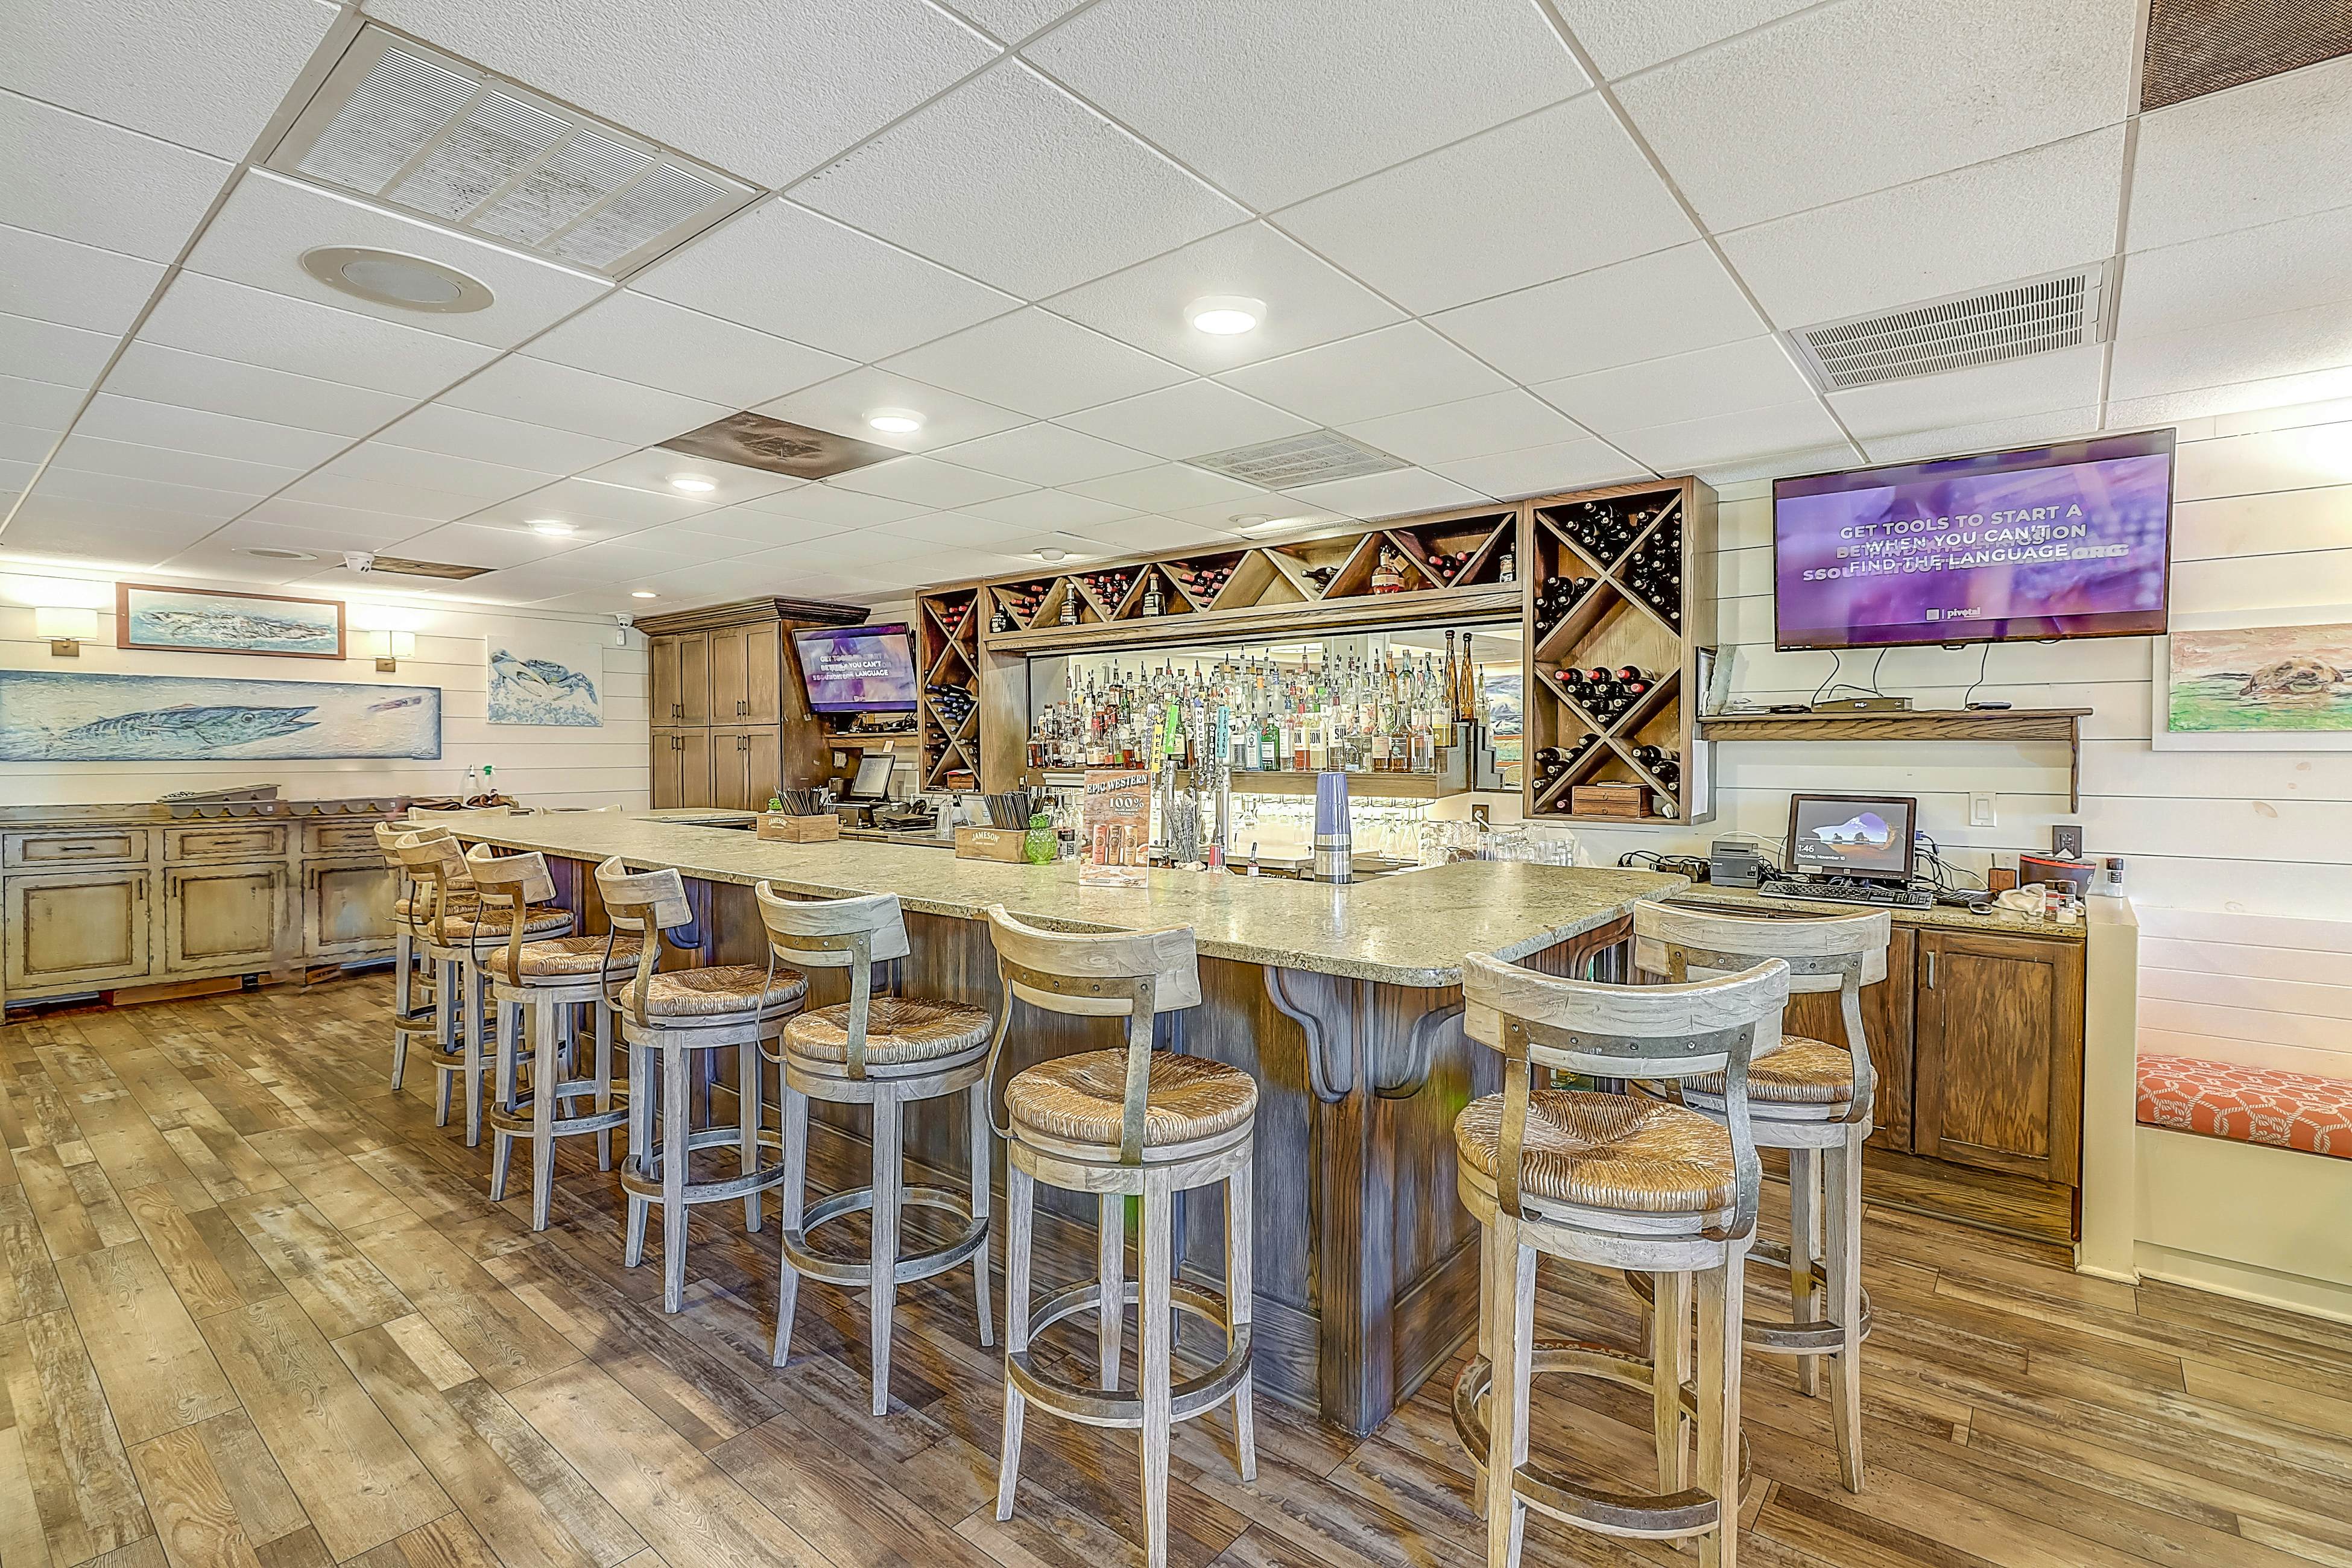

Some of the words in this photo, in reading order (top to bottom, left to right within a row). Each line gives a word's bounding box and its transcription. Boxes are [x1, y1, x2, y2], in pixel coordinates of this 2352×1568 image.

[1840, 524, 1877, 539] GET
[1882, 516, 1950, 536] TOOLS
[1955, 513, 1984, 529] TO
[1991, 505, 2060, 525] START
[2066, 504, 2083, 518] A
[1865, 536, 1927, 554] WHEN
[1933, 531, 1977, 547] YOU
[1984, 524, 2050, 543] CAN'T
[1849, 558, 1897, 574] FIND
[1902, 554, 1941, 569] THE
[1949, 543, 2069, 566] LANGUAGE
[1947, 607, 1981, 619] pivotal
[1087, 782, 1106, 794] EPIC
[1107, 774, 1148, 791] WESTERN
[1110, 797, 1144, 808] 100%
[972, 832, 1000, 843] JAMESON
[1798, 844, 1815, 853] 1:46
